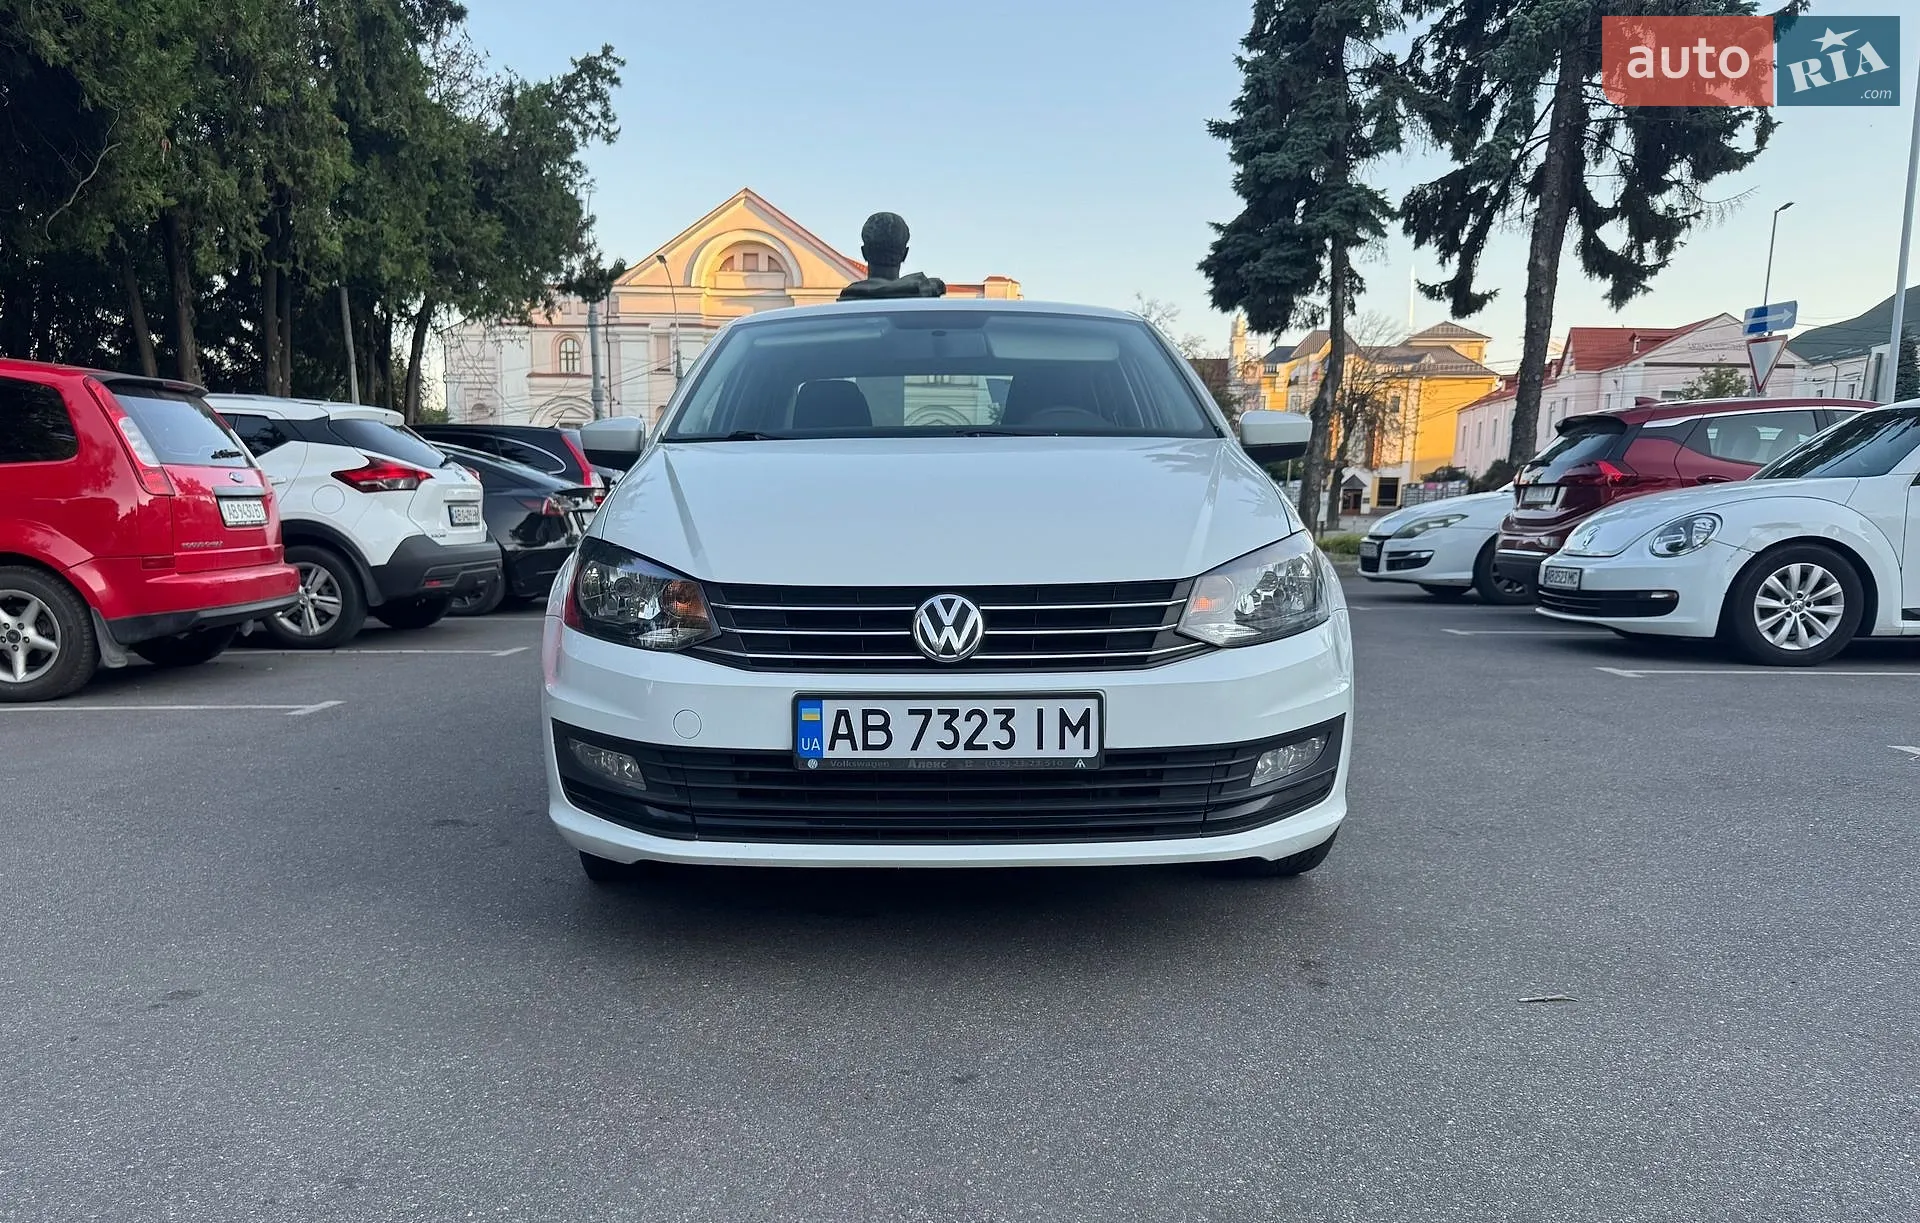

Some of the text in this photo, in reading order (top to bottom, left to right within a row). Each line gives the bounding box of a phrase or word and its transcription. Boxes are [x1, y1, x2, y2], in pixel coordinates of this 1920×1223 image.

[828, 707, 1092, 751] AB 7323 IM
[801, 737, 821, 751] UA
[830, 759, 890, 769] Volkswagen
